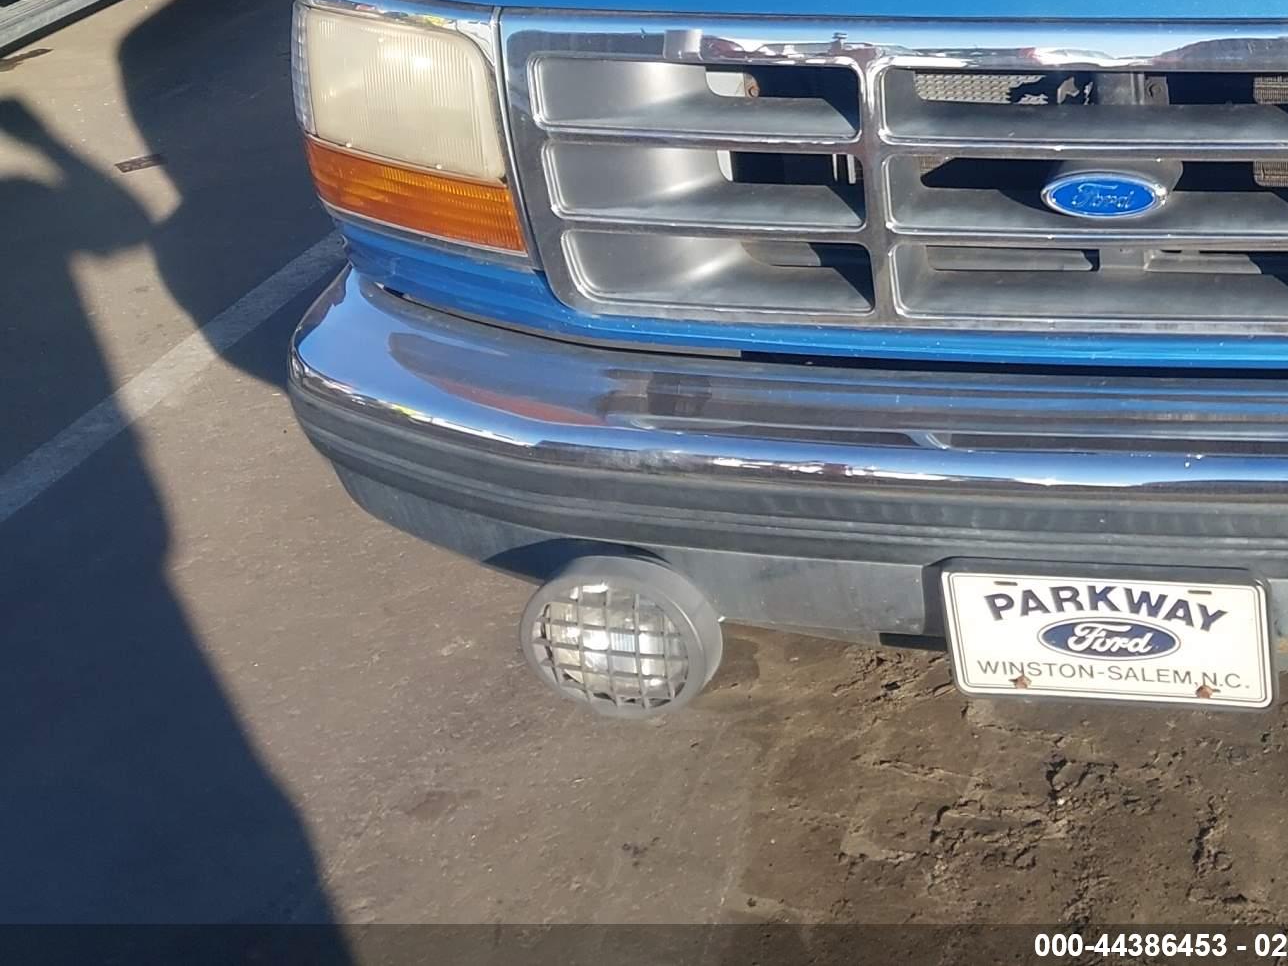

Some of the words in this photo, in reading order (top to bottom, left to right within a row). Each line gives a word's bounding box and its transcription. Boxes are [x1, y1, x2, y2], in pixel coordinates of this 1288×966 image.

[1071, 182, 1135, 209] Ford
[983, 585, 1228, 633] PARKWAY
[1067, 621, 1153, 655] Ford
